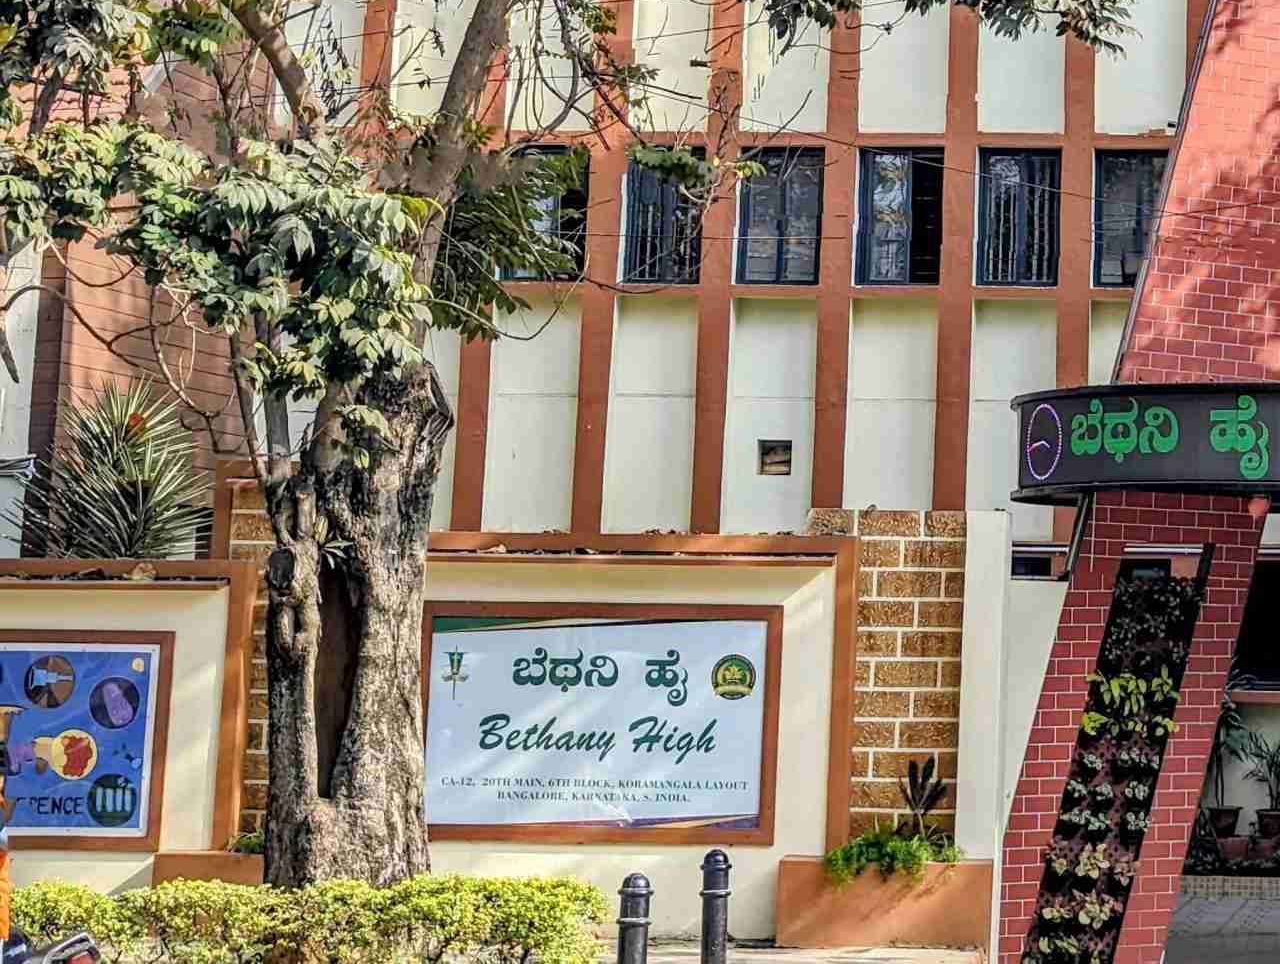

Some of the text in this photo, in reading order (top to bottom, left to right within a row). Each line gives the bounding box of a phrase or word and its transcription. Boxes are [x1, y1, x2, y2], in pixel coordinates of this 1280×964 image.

[1070, 396, 1180, 463] ಬೆಥನಿ
[1209, 394, 1271, 479] ಹೈ
[512, 647, 619, 692] ಬೆಥನಿ
[644, 650, 689, 707] ಹೈ
[478, 713, 718, 764] Bethany High
[481, 777, 511, 787] 20TH
[548, 778, 571, 788] 6TH
[618, 779, 701, 790] KORAMANGALA
[704, 780, 749, 791] LAYOUT
